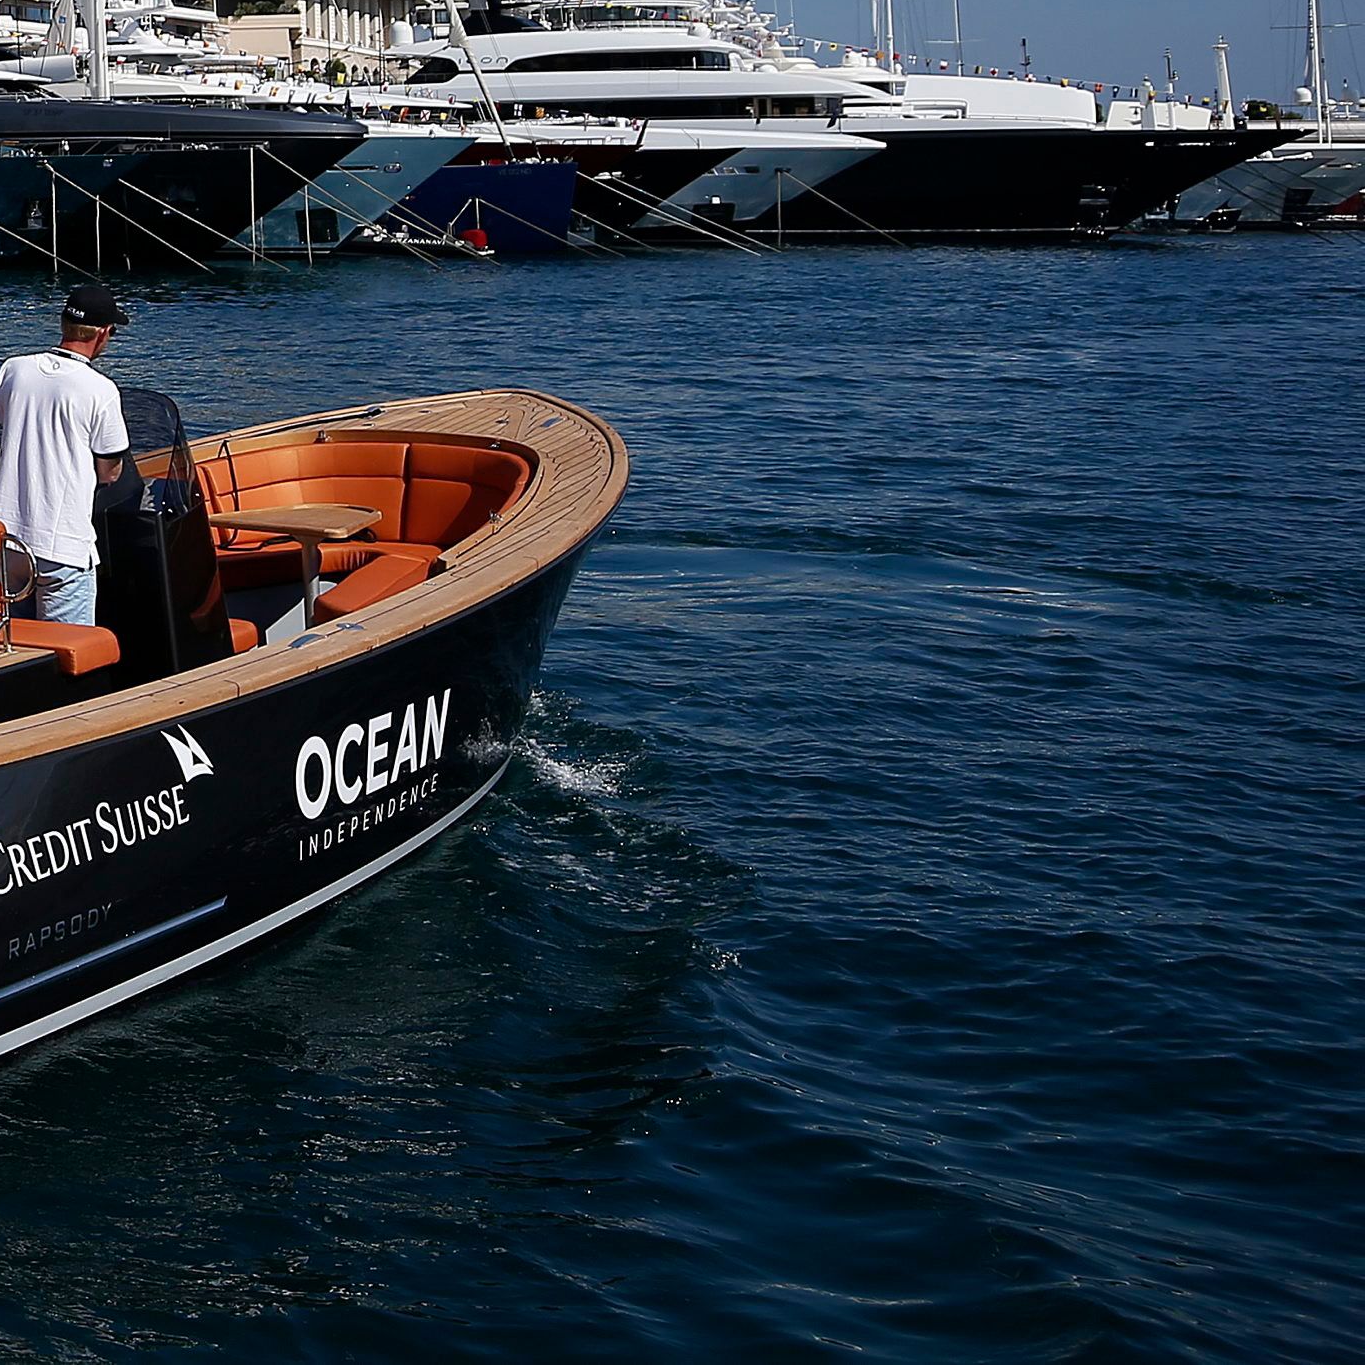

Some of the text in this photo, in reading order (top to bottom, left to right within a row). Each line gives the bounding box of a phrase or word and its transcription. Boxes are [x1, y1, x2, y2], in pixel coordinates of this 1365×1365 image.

[296, 688, 451, 820] OCEAN
[299, 773, 439, 861] INDEPENDENCE
[8, 902, 112, 960] RAPSODY
